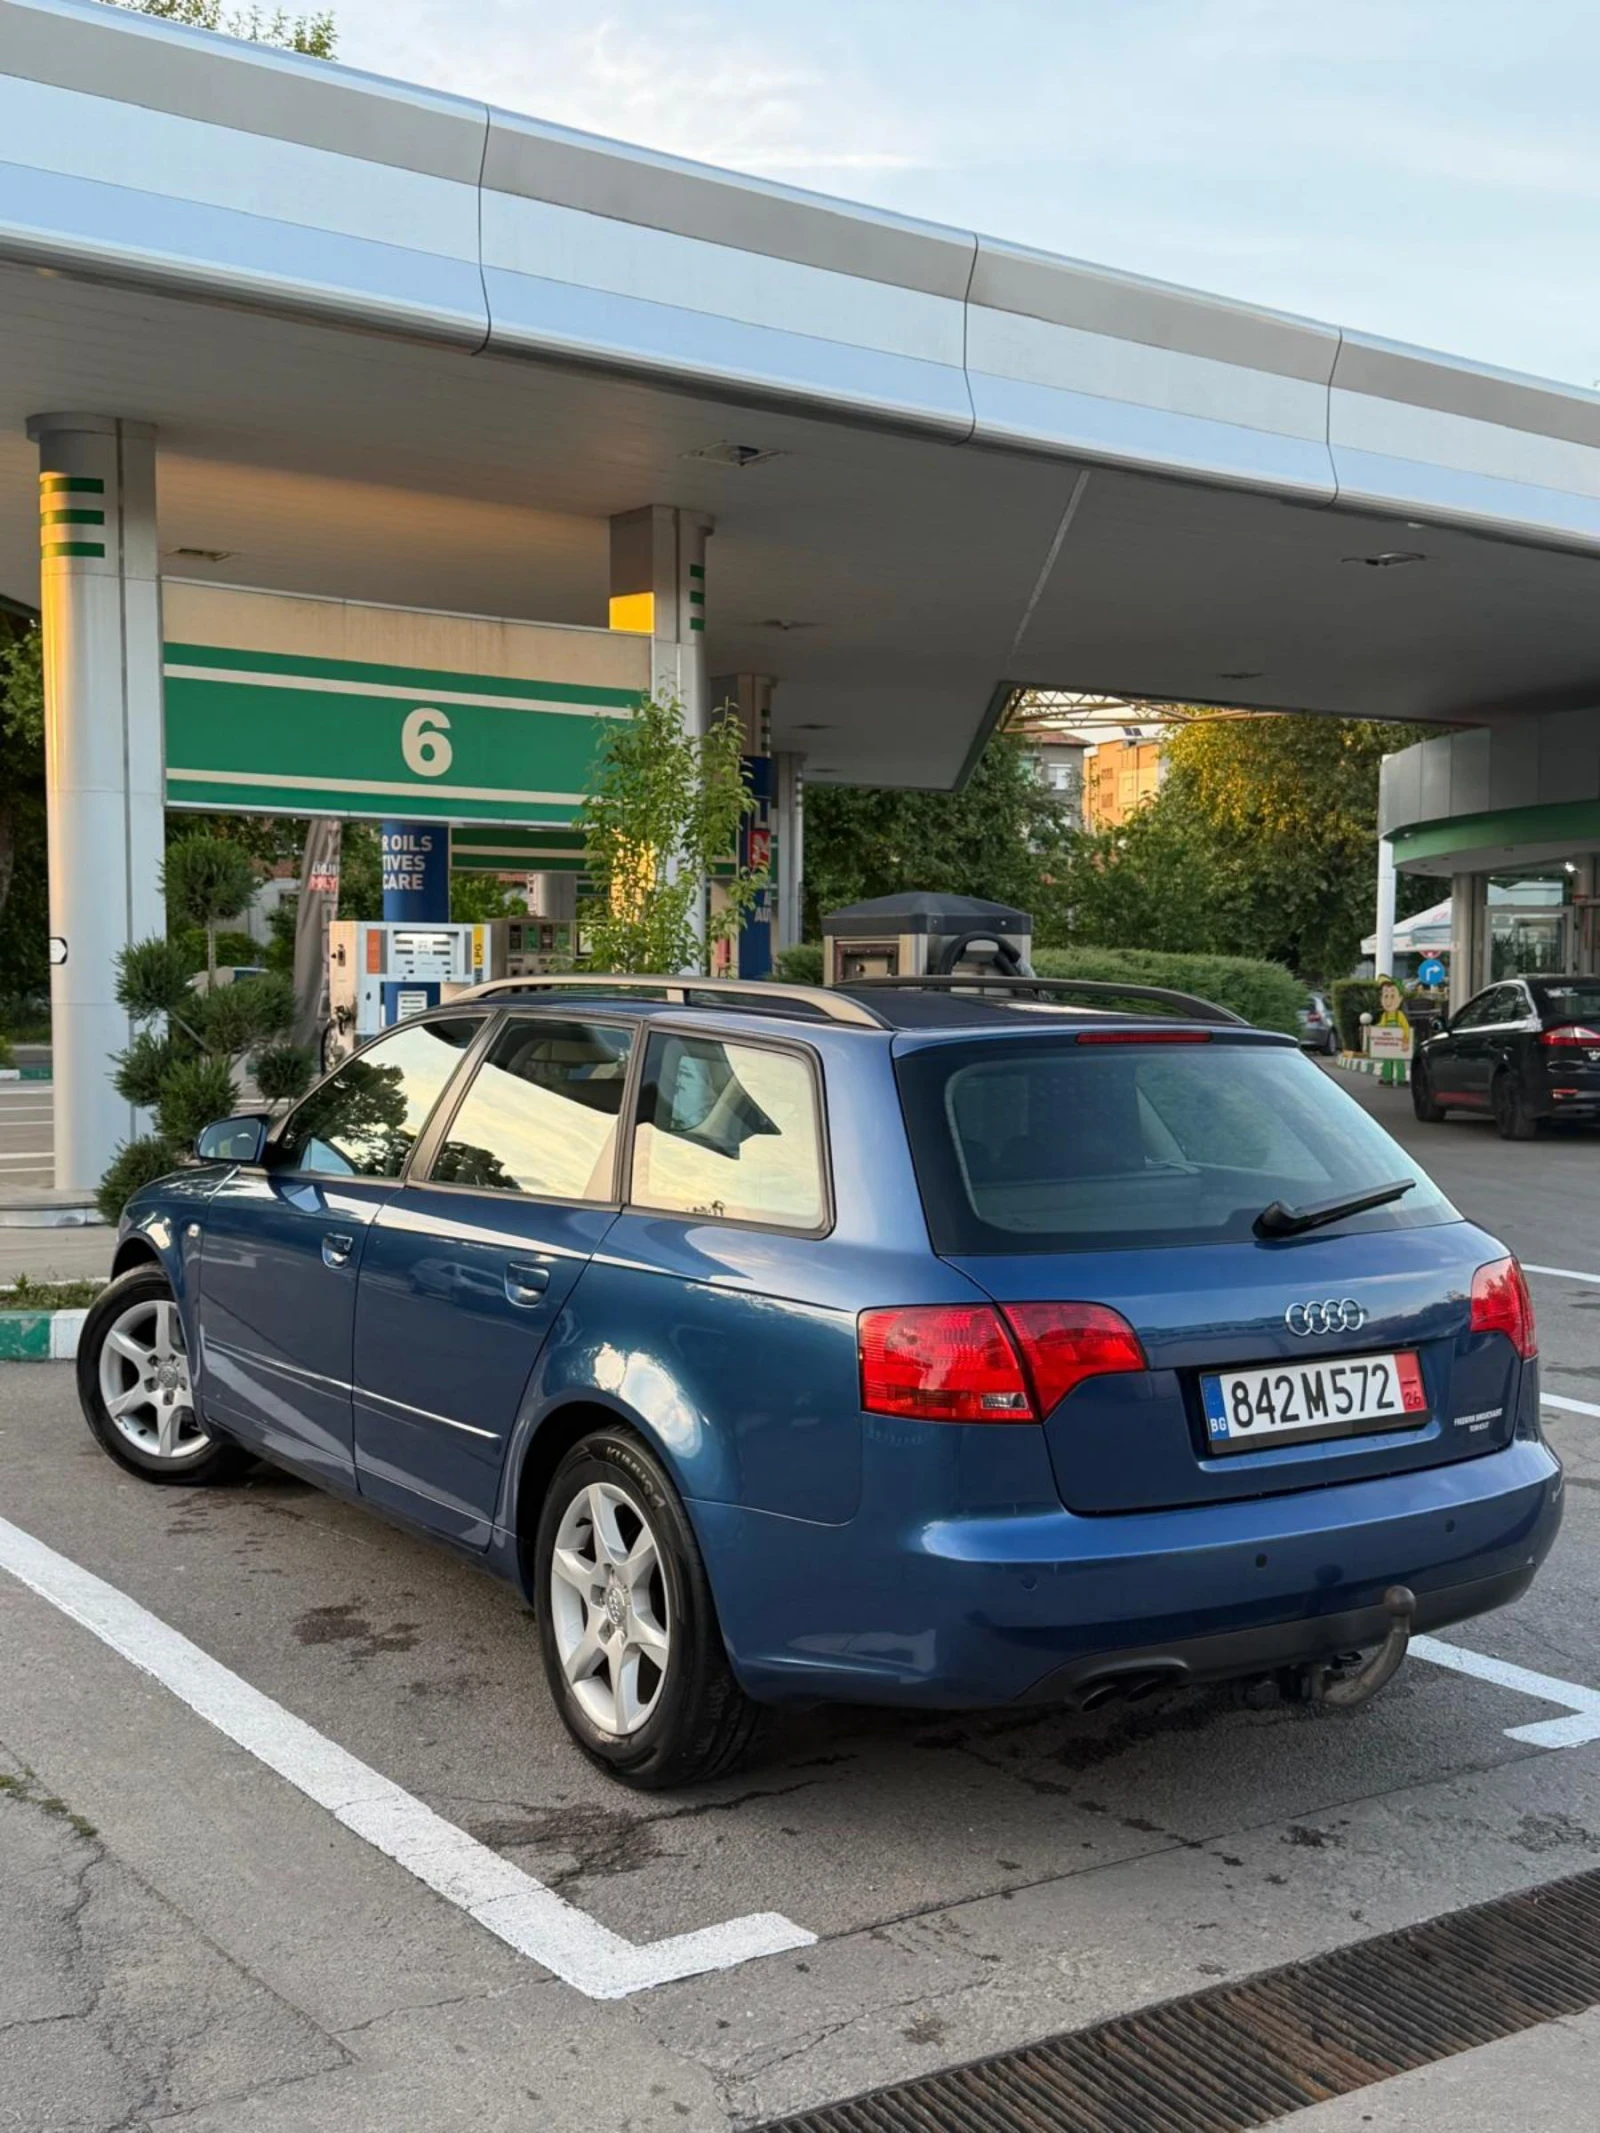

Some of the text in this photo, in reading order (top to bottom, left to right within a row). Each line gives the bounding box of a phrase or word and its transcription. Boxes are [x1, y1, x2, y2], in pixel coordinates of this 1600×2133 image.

[402, 707, 453, 777] 6
[391, 835, 433, 851] OILS
[383, 873, 424, 890] CARE
[1209, 1363, 1421, 1433] BG 842M572 26
